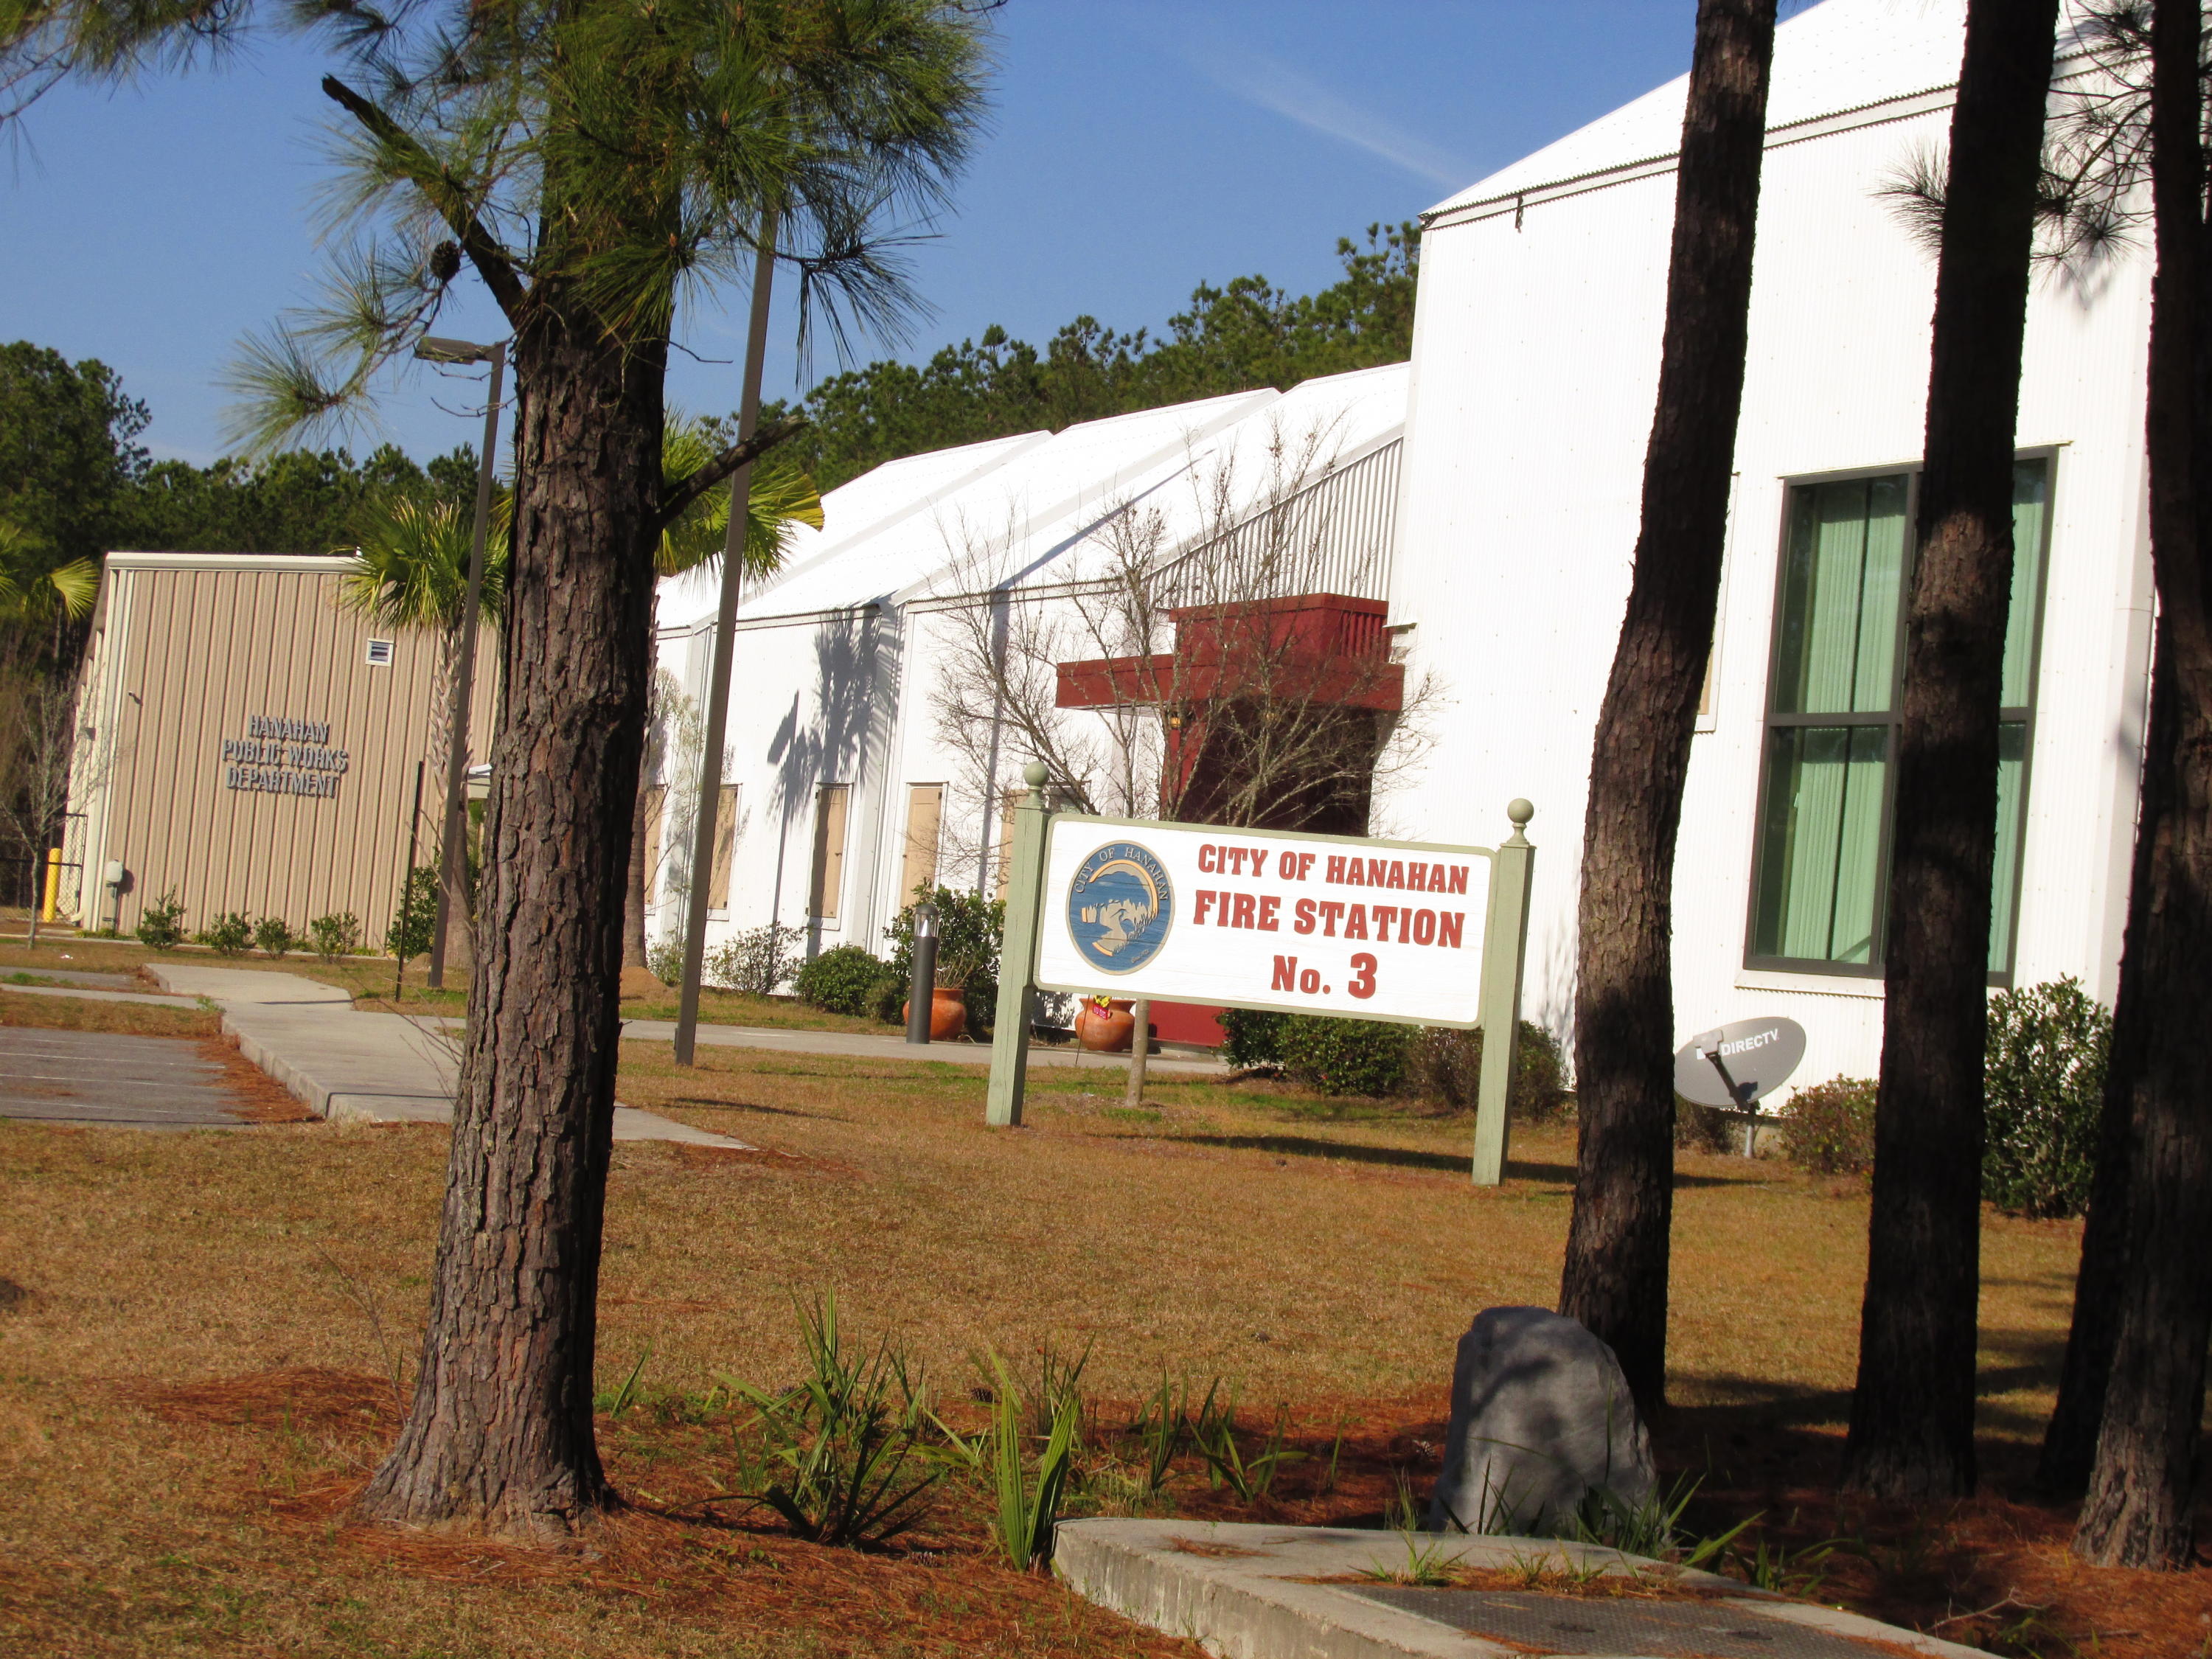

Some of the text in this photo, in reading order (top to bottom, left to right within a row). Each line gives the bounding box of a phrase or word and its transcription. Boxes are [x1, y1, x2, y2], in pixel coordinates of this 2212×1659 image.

[249, 714, 330, 745] HANAHAN
[222, 738, 349, 773] PUBLIC WORKS
[226, 766, 340, 799] DEPARTMENT
[1074, 847, 1169, 901] CITY OF HANAHAN
[1198, 844, 1470, 895] CITY OF HANAHAN
[1193, 889, 1465, 949] FIRE STATION
[1271, 952, 1378, 1000] No. 3
[1721, 1029, 1778, 1057] DIRECTV
